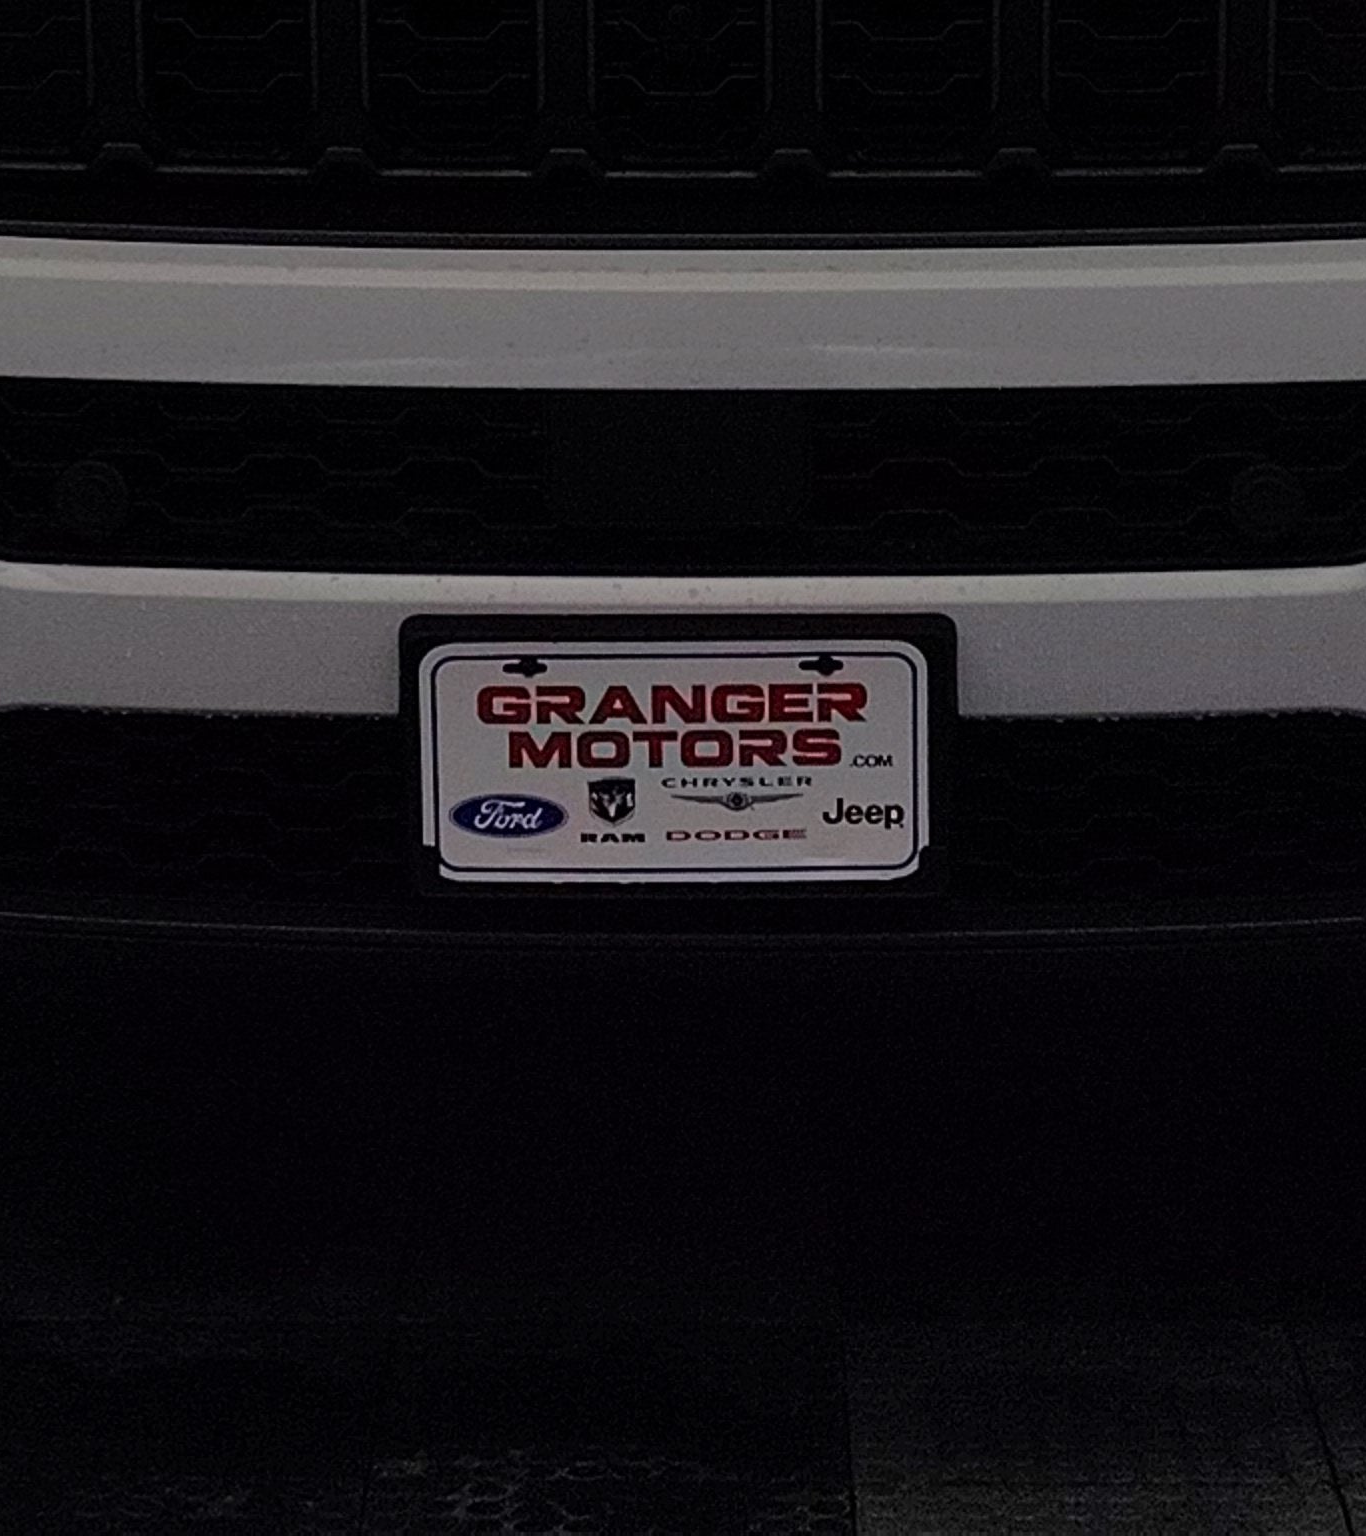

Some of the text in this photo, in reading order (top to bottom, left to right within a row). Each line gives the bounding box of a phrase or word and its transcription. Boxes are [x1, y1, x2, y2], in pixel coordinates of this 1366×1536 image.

[476, 682, 868, 725] GRANGER
[508, 729, 894, 769] MOTORS .COM
[661, 775, 813, 789] CHRYSLER
[473, 798, 544, 830] Ford
[822, 797, 905, 830] Jeep
[579, 831, 646, 844] RAM
[665, 829, 808, 842] DODGE
